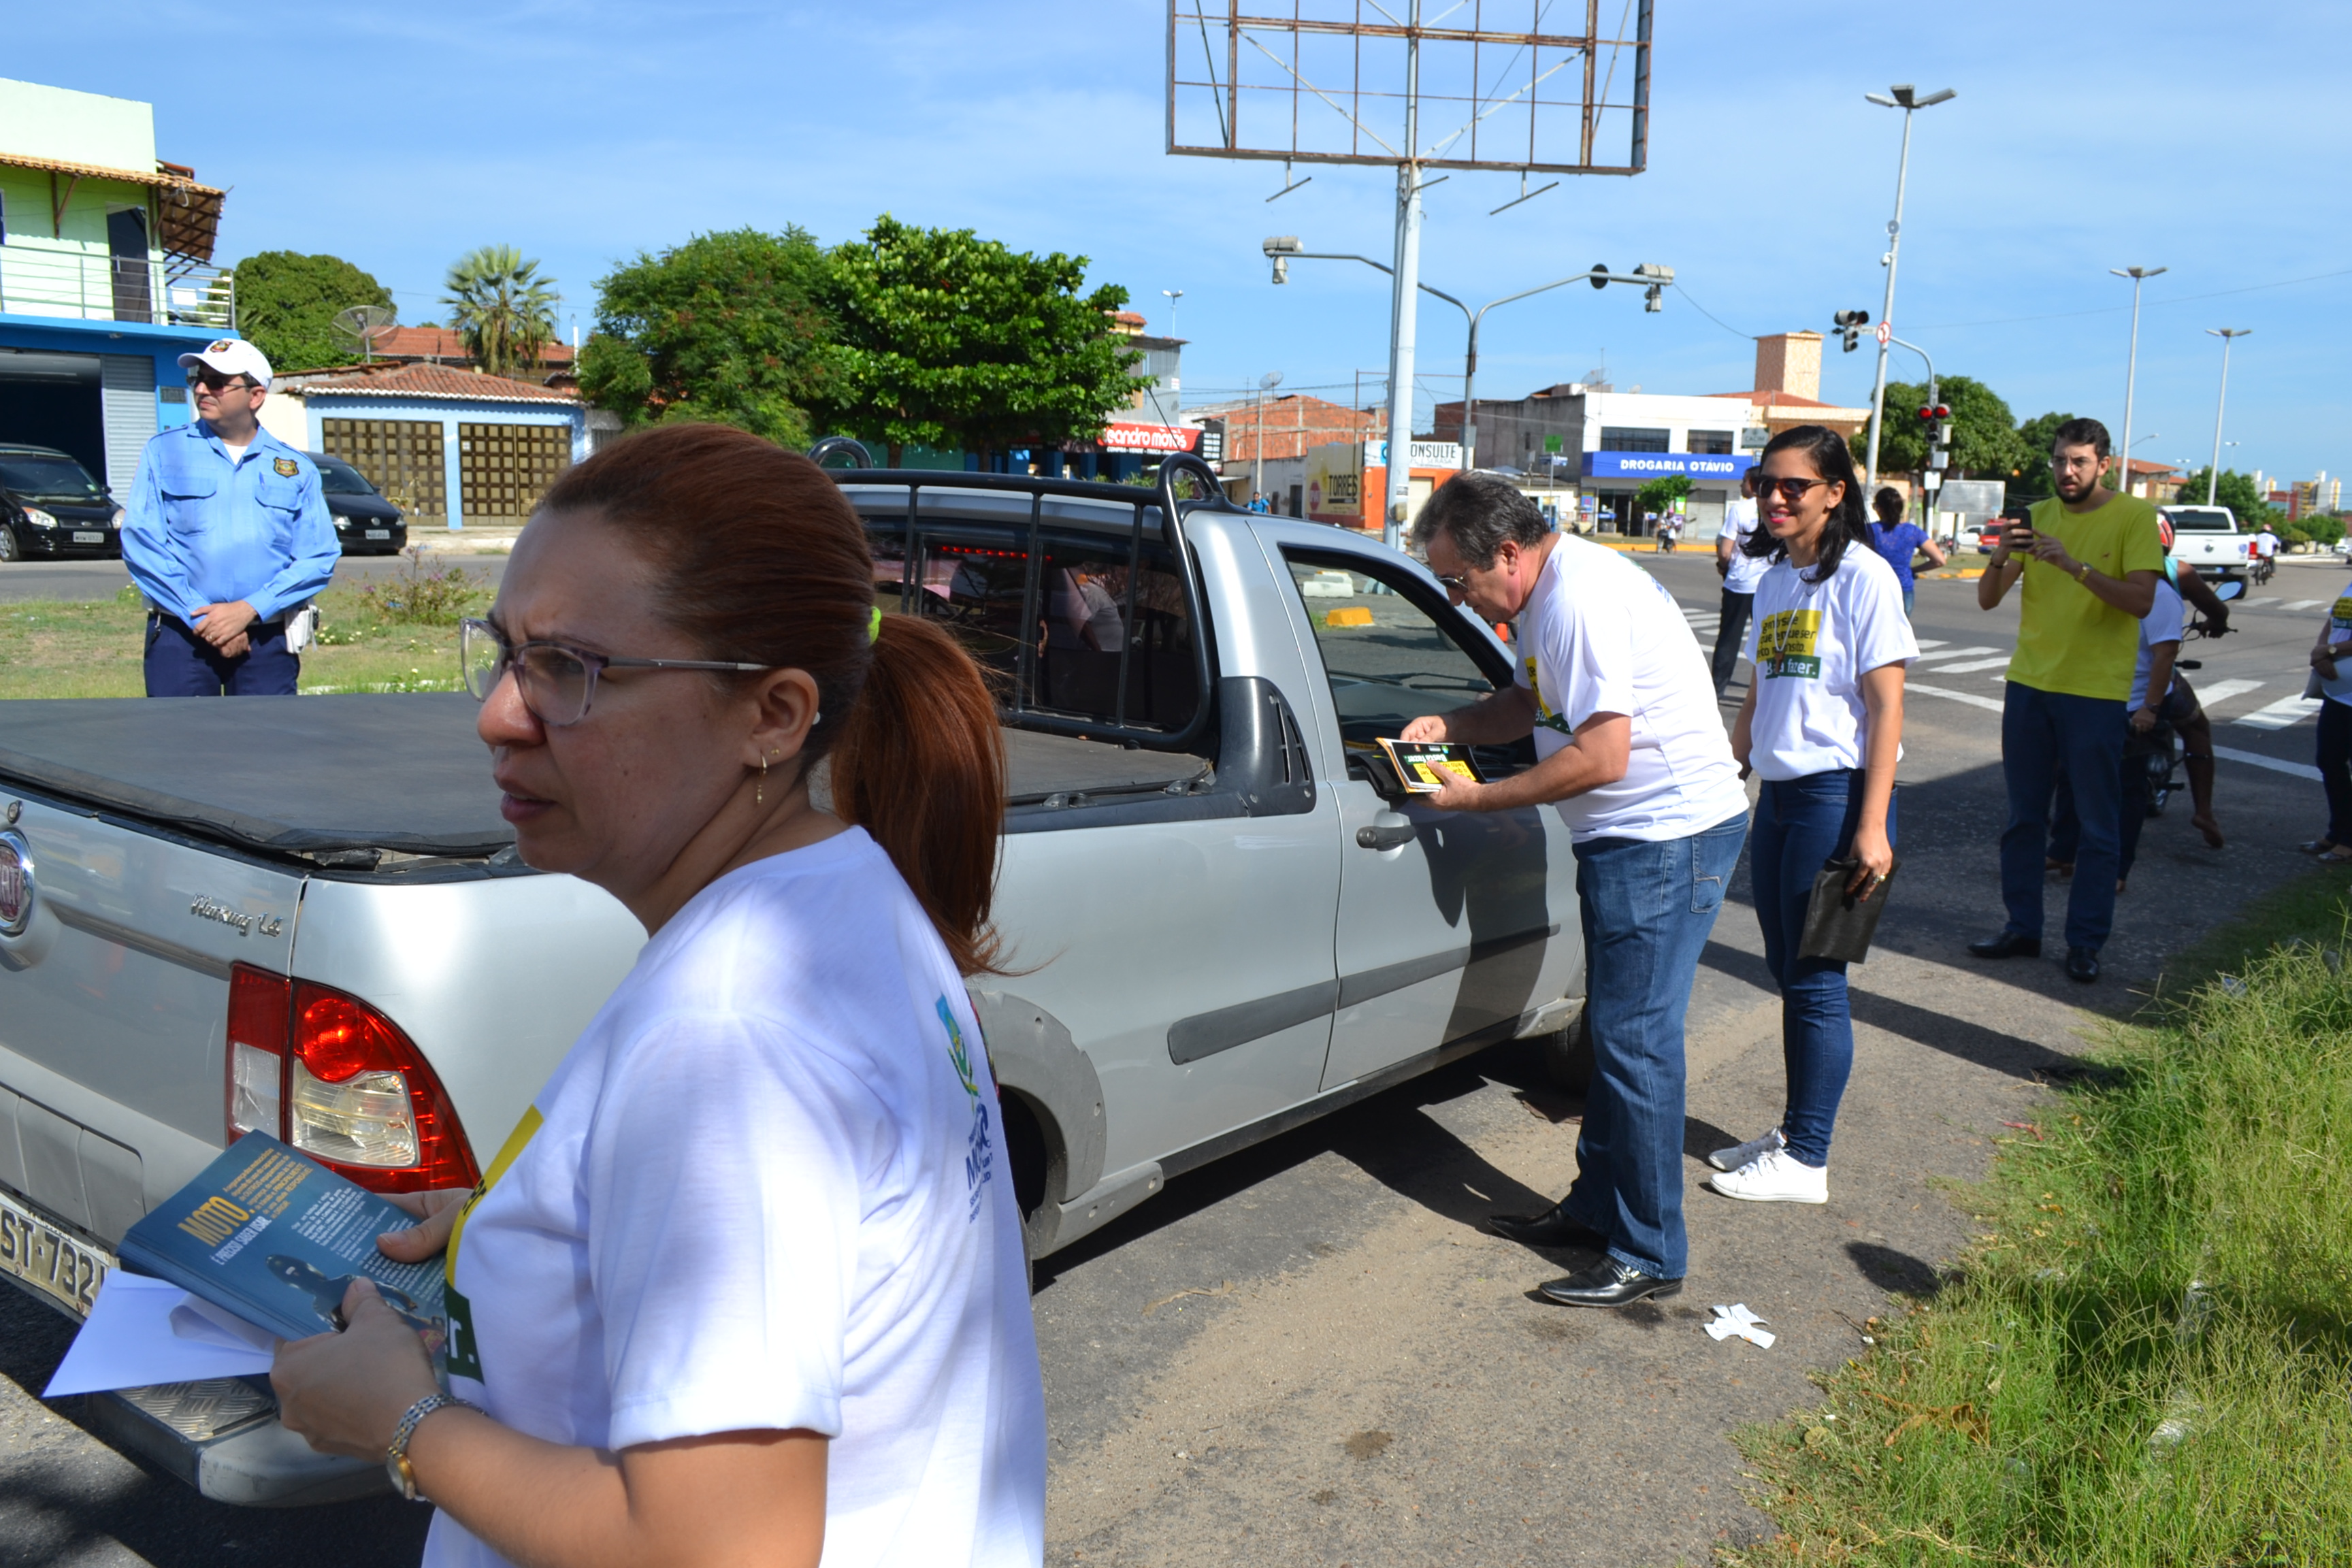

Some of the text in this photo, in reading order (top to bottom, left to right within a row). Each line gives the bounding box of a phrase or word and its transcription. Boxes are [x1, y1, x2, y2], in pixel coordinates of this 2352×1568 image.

[1410, 444, 1456, 458] ONSULTE
[1620, 459, 1734, 472] DROGARIA OTÁVIO
[1328, 474, 1358, 498] TORRES
[215, 1239, 244, 1262] PRECISO
[235, 1226, 259, 1246] SABER
